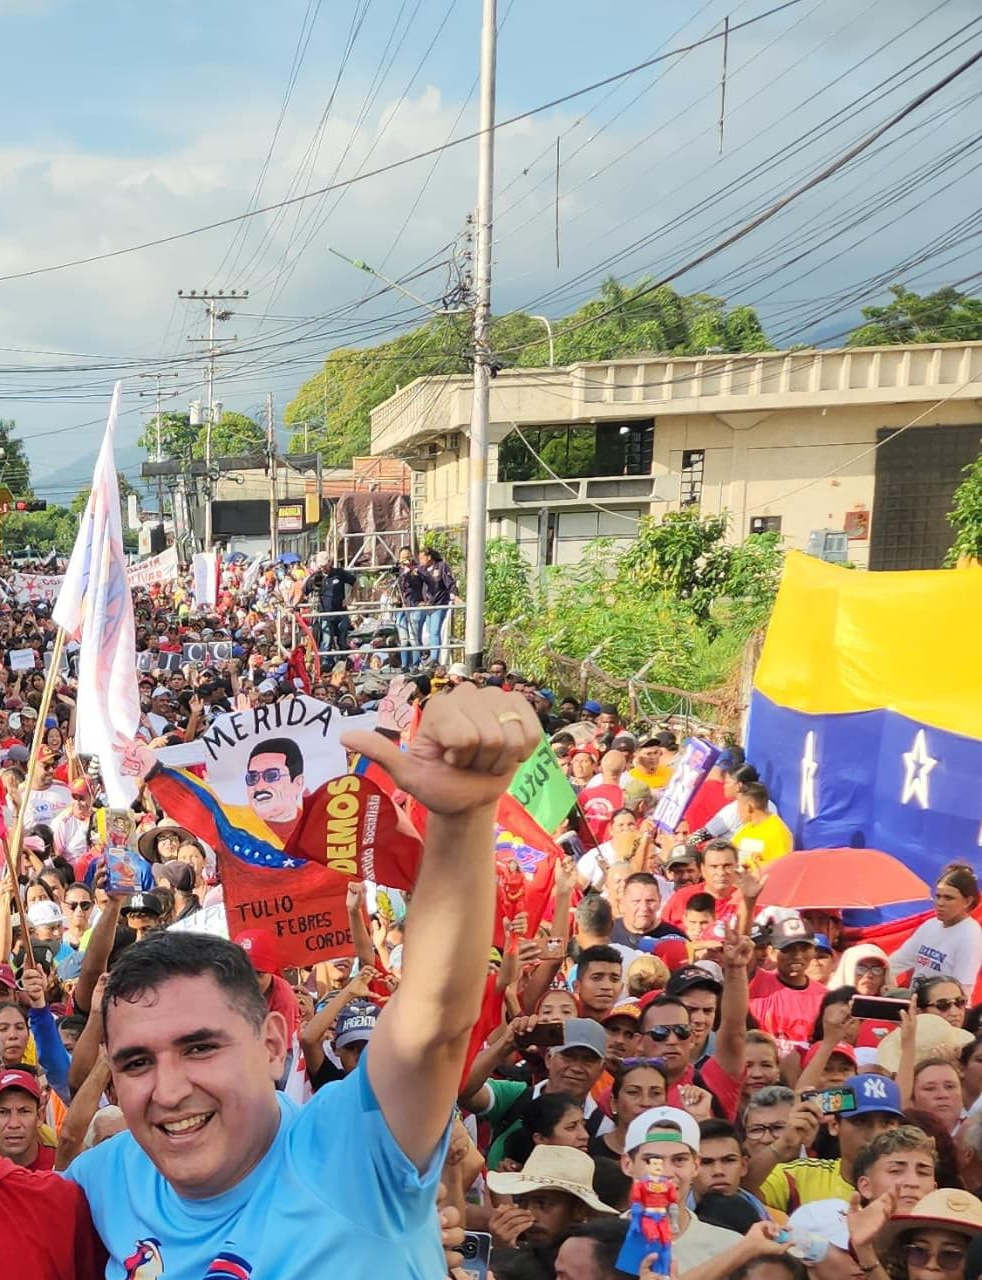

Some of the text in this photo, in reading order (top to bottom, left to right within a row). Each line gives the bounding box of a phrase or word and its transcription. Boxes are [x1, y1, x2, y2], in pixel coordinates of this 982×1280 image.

[203, 699, 333, 760] MERIDA
[236, 895, 294, 922] TULIO
[276, 911, 332, 937] FEBRES
